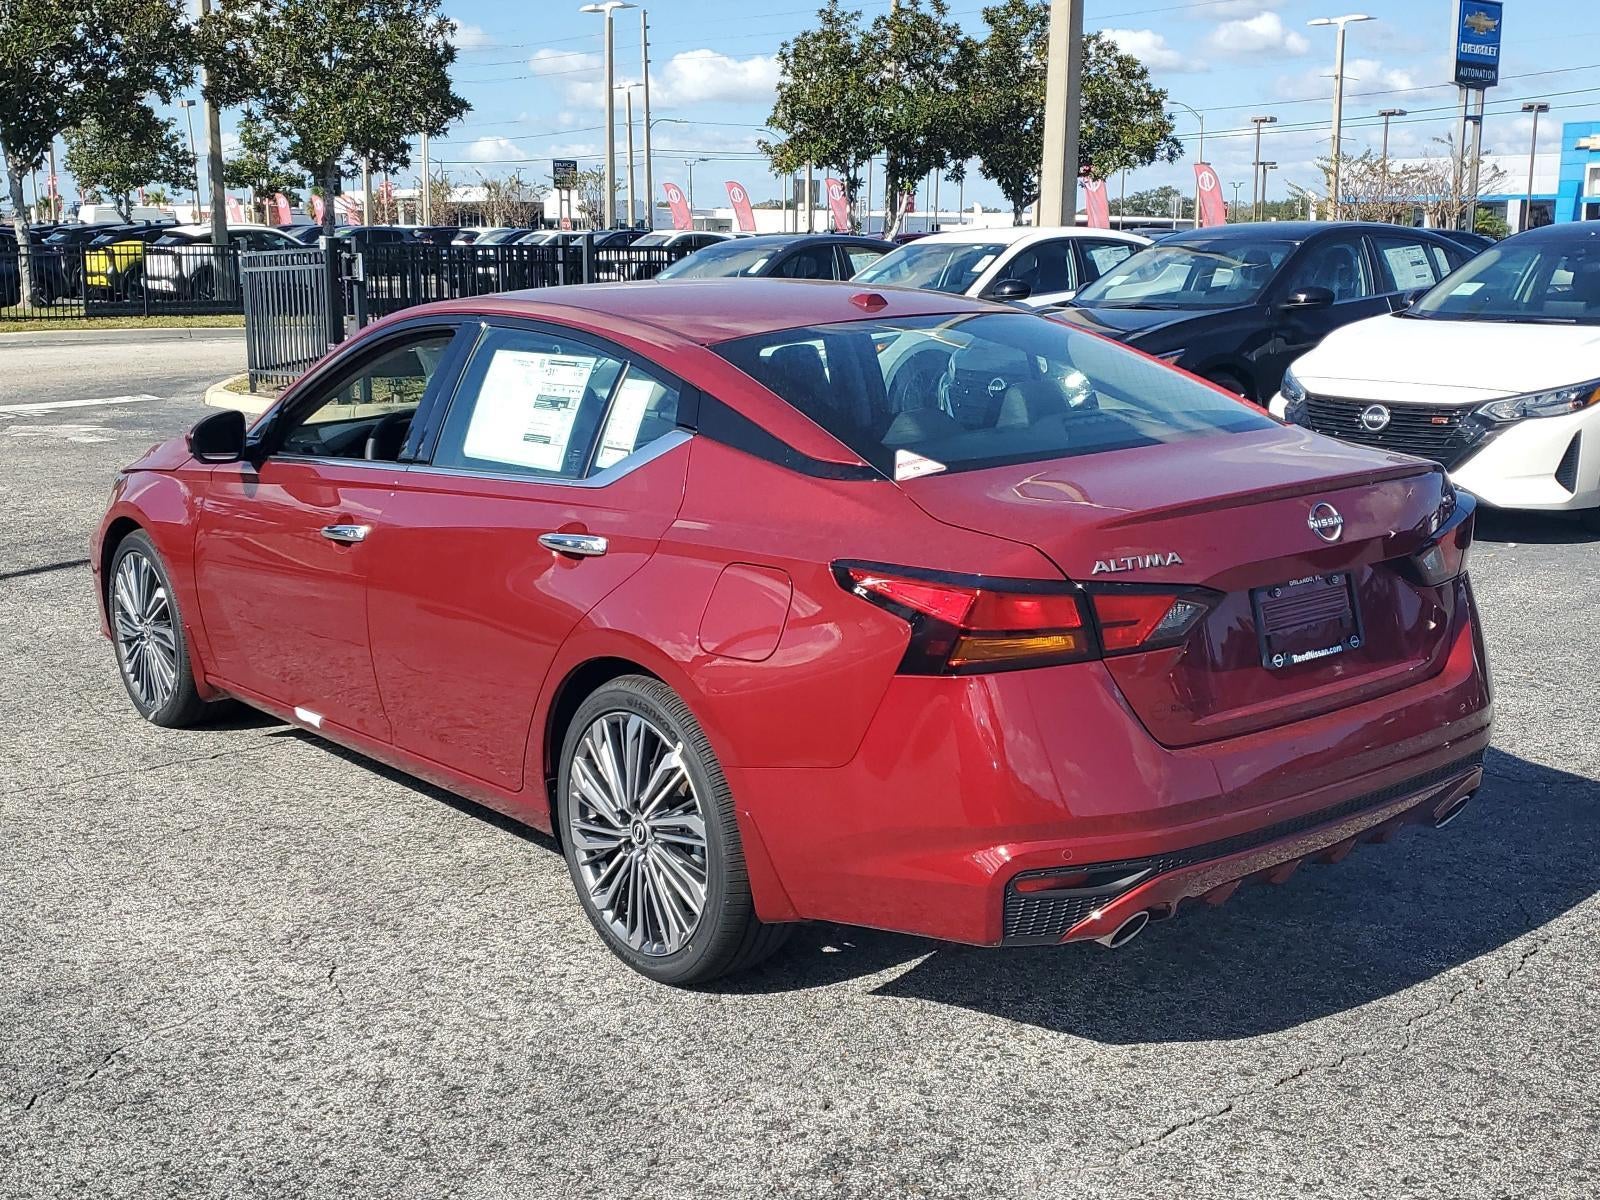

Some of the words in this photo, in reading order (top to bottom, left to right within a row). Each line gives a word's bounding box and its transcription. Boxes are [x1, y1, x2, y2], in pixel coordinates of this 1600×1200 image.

[1461, 42, 1498, 57] CHEVROLET
[1460, 67, 1496, 80] AUTONATION
[1361, 413, 1391, 423] NISSAN
[1307, 514, 1344, 529] NISSAN
[1091, 551, 1184, 575] ALTIMA
[1291, 645, 1343, 664] ReedNissan.com
